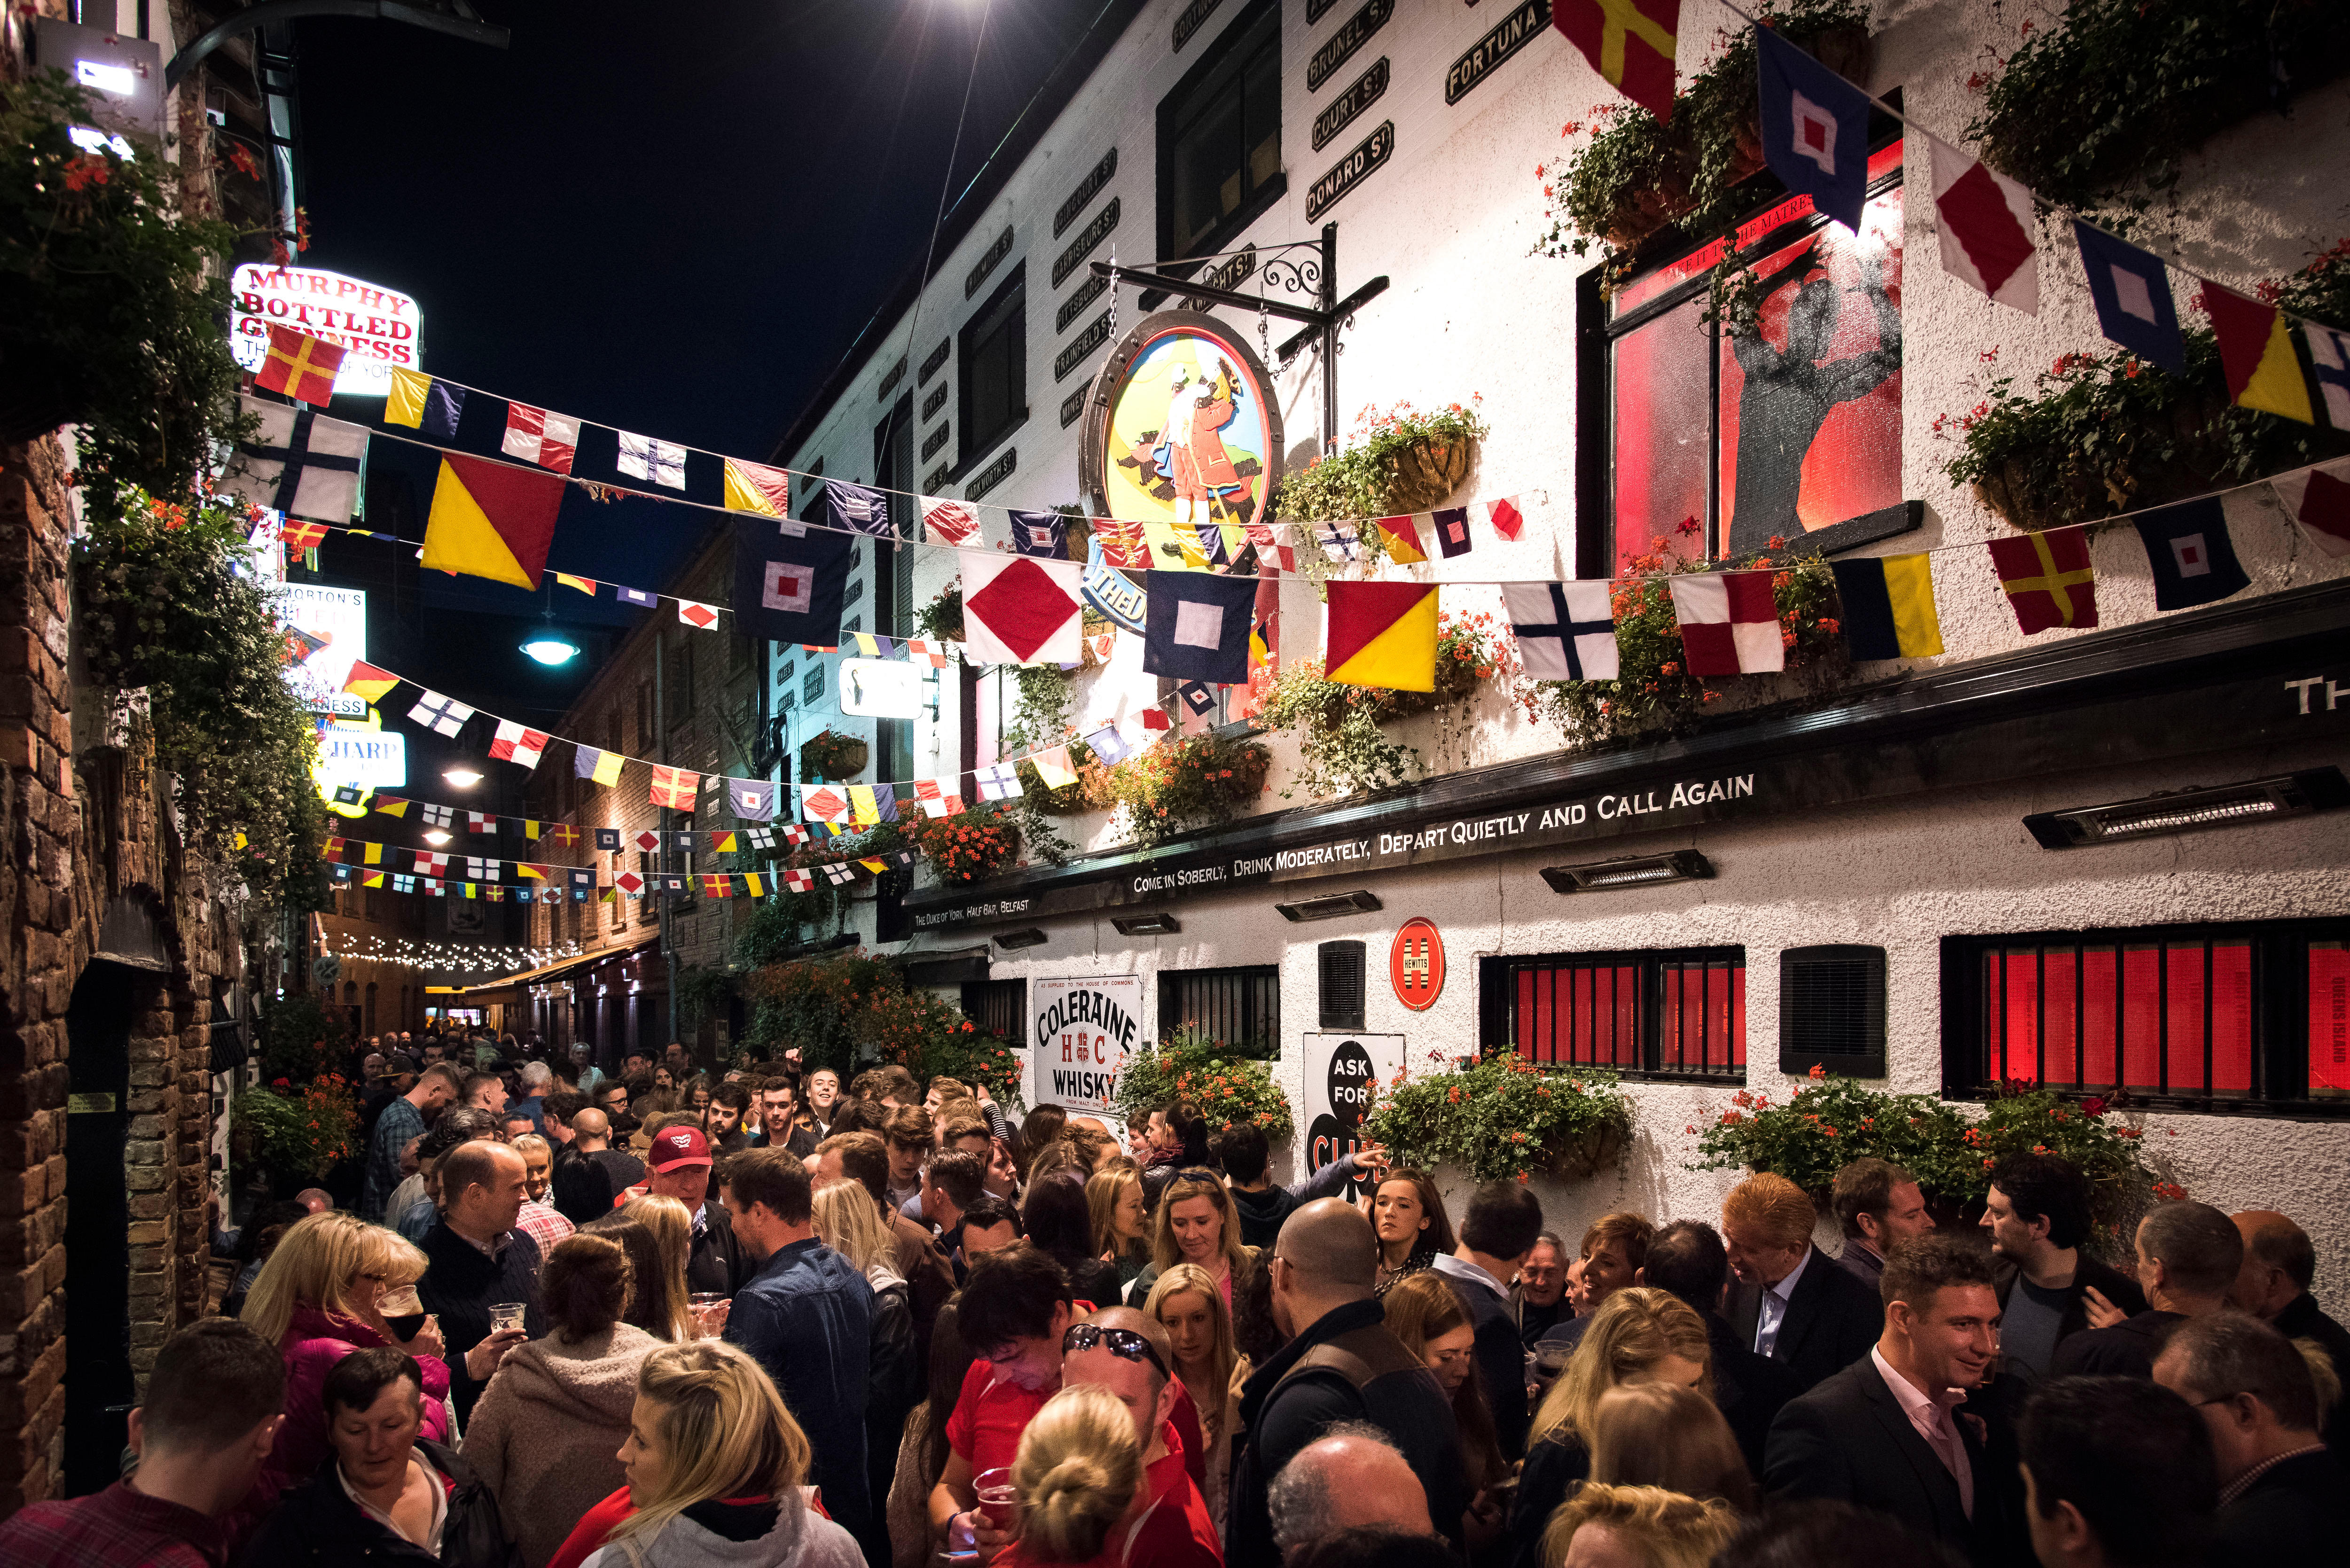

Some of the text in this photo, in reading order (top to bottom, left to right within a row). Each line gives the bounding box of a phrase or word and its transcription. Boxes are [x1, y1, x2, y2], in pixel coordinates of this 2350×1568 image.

[1310, 19, 1363, 81] BRUNEL
[1450, 5, 1537, 97] FORTUNA
[1315, 87, 1358, 143] COURT
[1055, 169, 1098, 231] AGINCOURT
[1308, 150, 1364, 212] DONARD
[1053, 219, 1102, 281] HARRISBURG
[1662, 260, 1692, 283] TAKE
[1696, 250, 1708, 266] IT
[1739, 227, 1757, 242] HE
[1760, 195, 1813, 232] MATRES
[242, 291, 412, 340] BOTTLED
[247, 269, 409, 315] MURPHY
[1058, 277, 1099, 328] PITTSBURG
[244, 340, 266, 357] TH
[363, 362, 392, 378] YOR
[1057, 326, 1099, 373] TRAINFIELD
[1062, 388, 1088, 421] MINER
[1092, 567, 1132, 614] THE
[2284, 675, 2350, 715] TH
[1234, 857, 1273, 876] DRINK
[1380, 827, 1448, 855] DEPART
[1451, 813, 1530, 845] QUIETLY
[1539, 804, 1586, 830] AND
[1597, 795, 1663, 820] CALL
[1668, 774, 1754, 809] AGAIN
[1404, 959, 1427, 968] HEWITTS
[1038, 990, 1136, 1055] COLERAINE
[2331, 977, 2346, 1063] QUEENS ISLAND
[1061, 1034, 1105, 1064] H C
[1334, 1059, 1368, 1076] ASK
[1053, 1069, 1117, 1101] WHISKY
[1334, 1086, 1367, 1103] FOR
